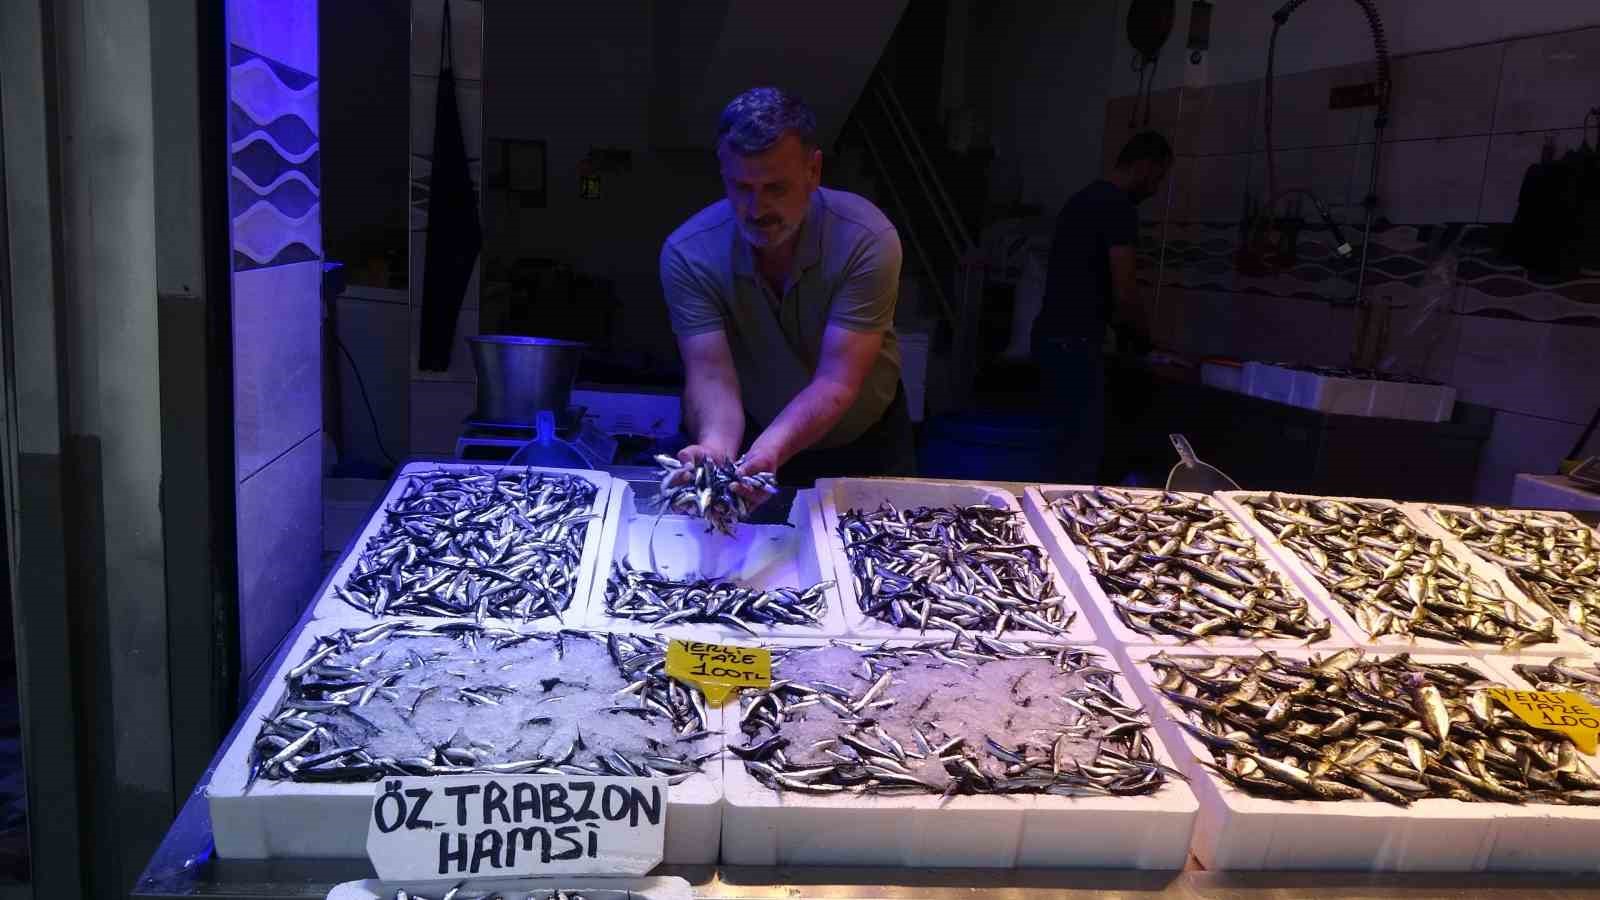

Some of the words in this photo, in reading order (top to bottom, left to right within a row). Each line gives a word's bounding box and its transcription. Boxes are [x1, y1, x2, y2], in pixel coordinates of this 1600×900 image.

[691, 653, 757, 664] TAZE
[1520, 703, 1590, 714] TAZE
[444, 780, 662, 827] TRABZON
[438, 822, 600, 874] HAMSİ
